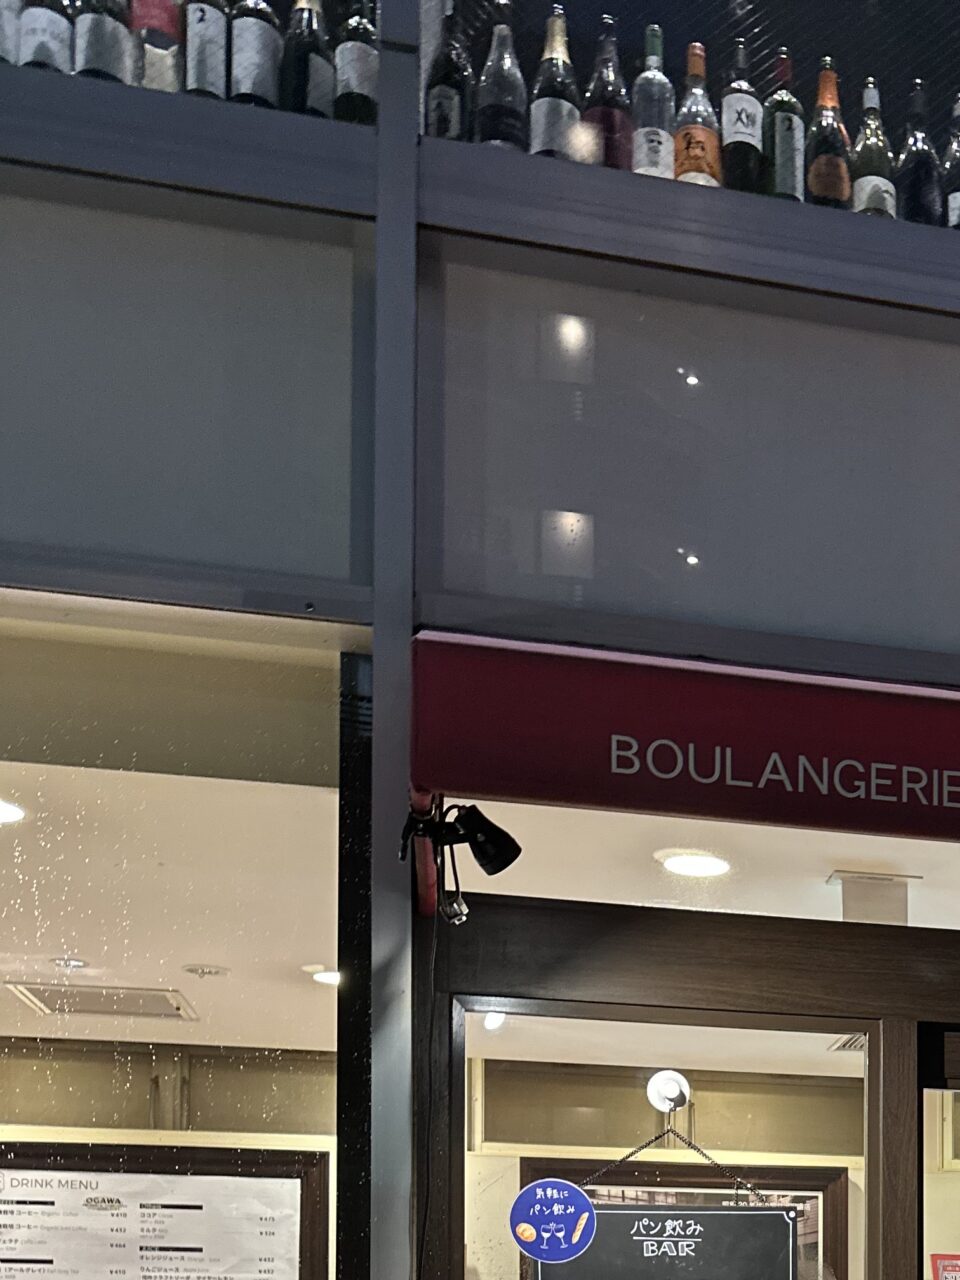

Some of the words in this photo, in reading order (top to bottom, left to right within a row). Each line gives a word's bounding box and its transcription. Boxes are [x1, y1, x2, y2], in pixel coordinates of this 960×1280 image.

[10, 1177, 53, 1188] DRINK
[58, 1179, 99, 1190] MENU
[530, 1204, 575, 1216] パン飲み
[630, 1218, 704, 1237] パン飲み
[643, 1241, 696, 1257] BAR
